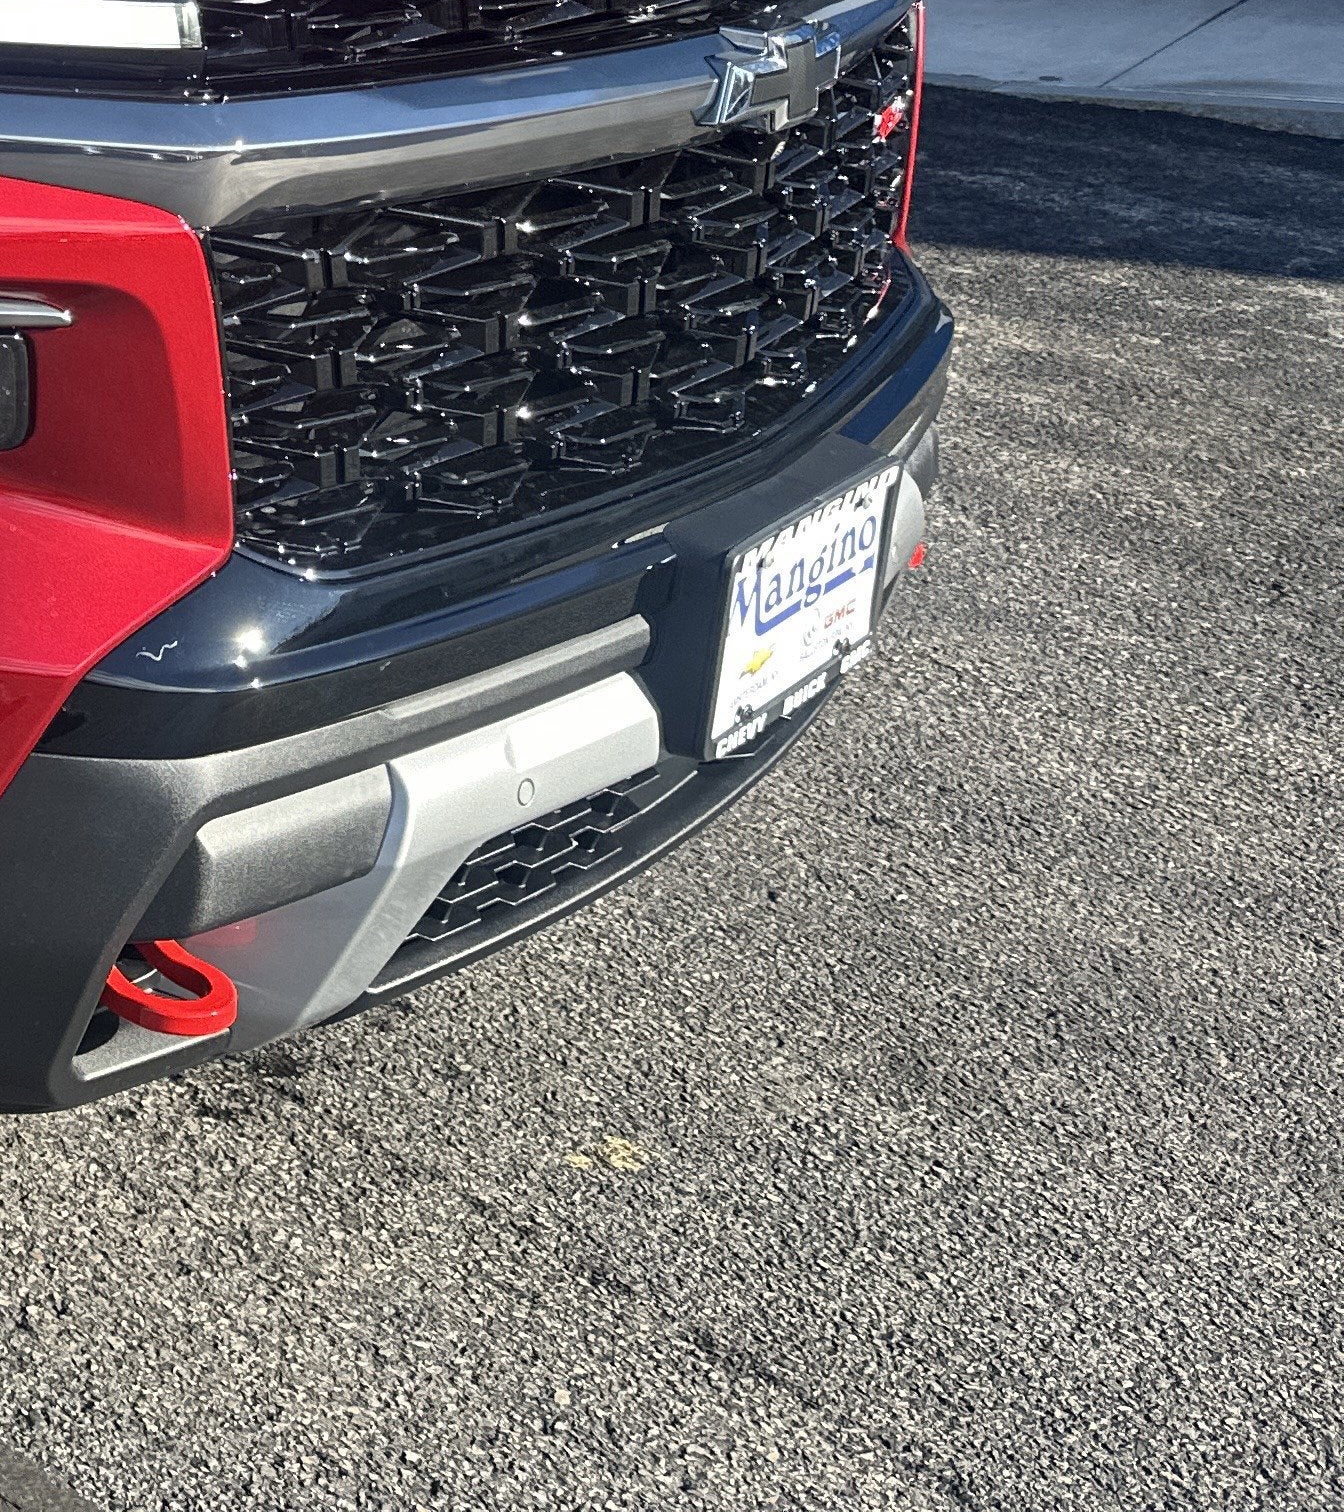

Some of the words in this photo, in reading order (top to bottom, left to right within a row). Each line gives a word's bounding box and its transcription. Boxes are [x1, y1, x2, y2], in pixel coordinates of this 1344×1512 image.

[730, 515, 877, 636] Mangino
[824, 597, 857, 630] GMC
[715, 712, 768, 759] CHEVY
[782, 671, 828, 716] BUICK
